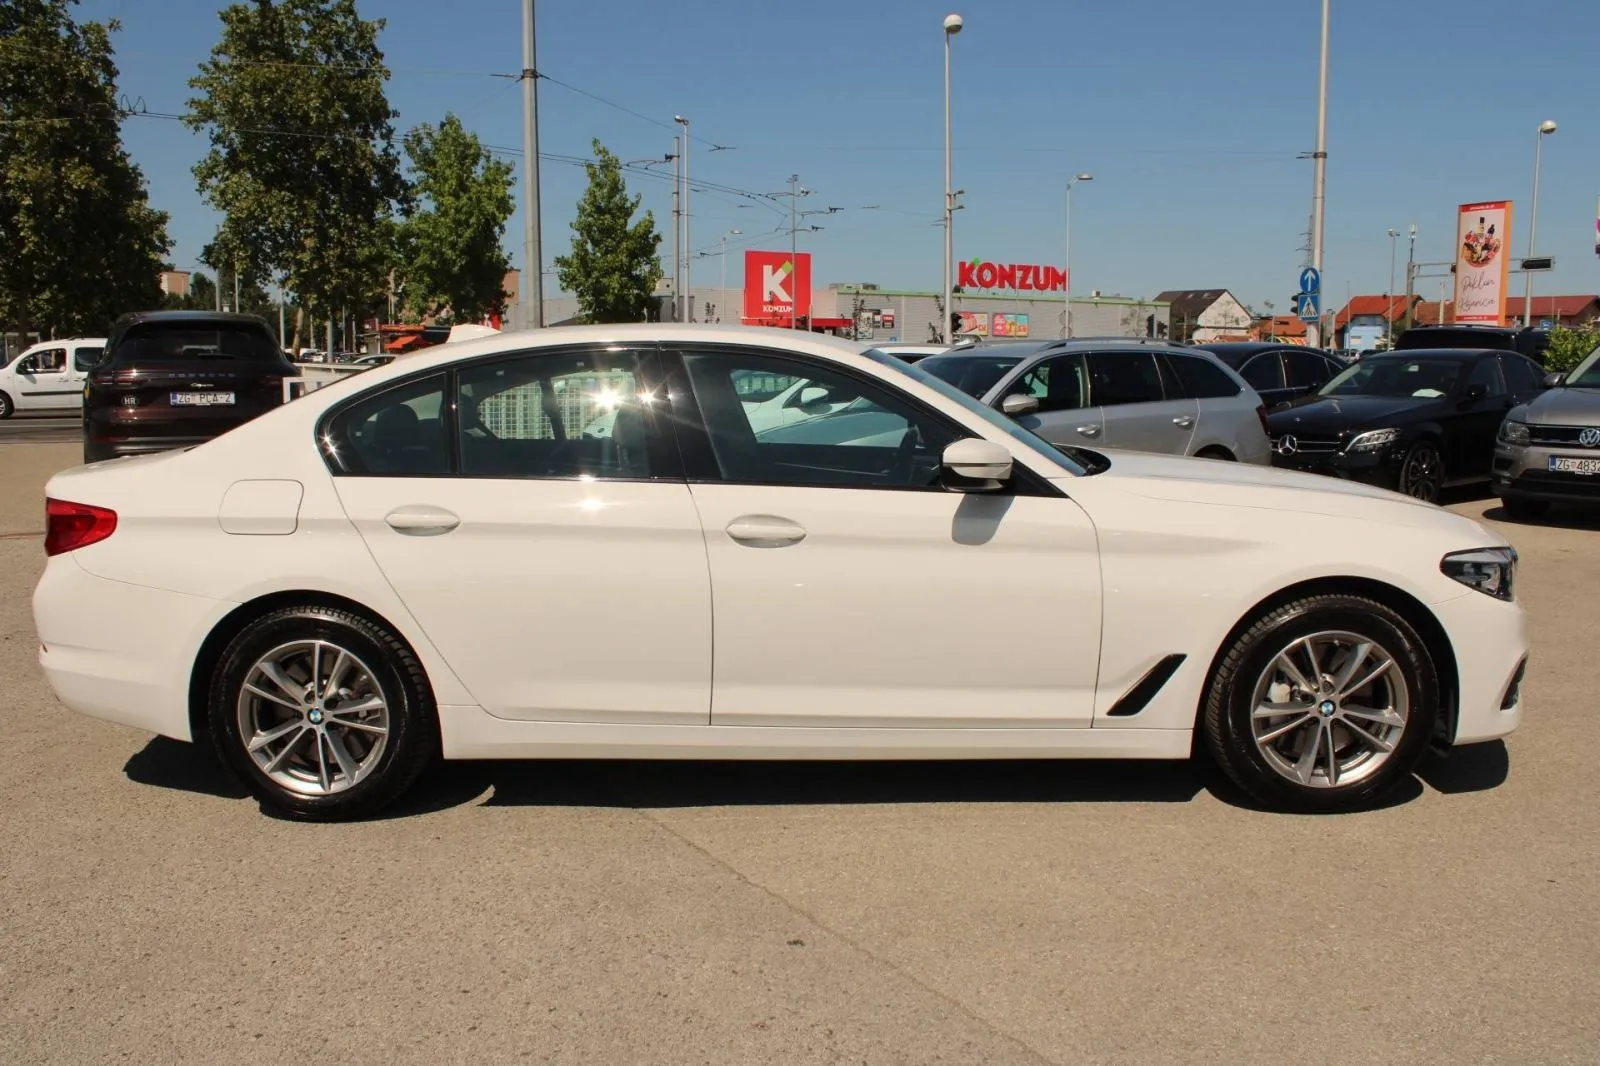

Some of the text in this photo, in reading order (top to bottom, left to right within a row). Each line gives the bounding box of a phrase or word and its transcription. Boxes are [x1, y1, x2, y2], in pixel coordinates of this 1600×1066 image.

[959, 258, 1070, 292] KONZUM
[124, 397, 136, 405] HR
[179, 393, 191, 403] ZG
[1557, 459, 1570, 471] ZG
